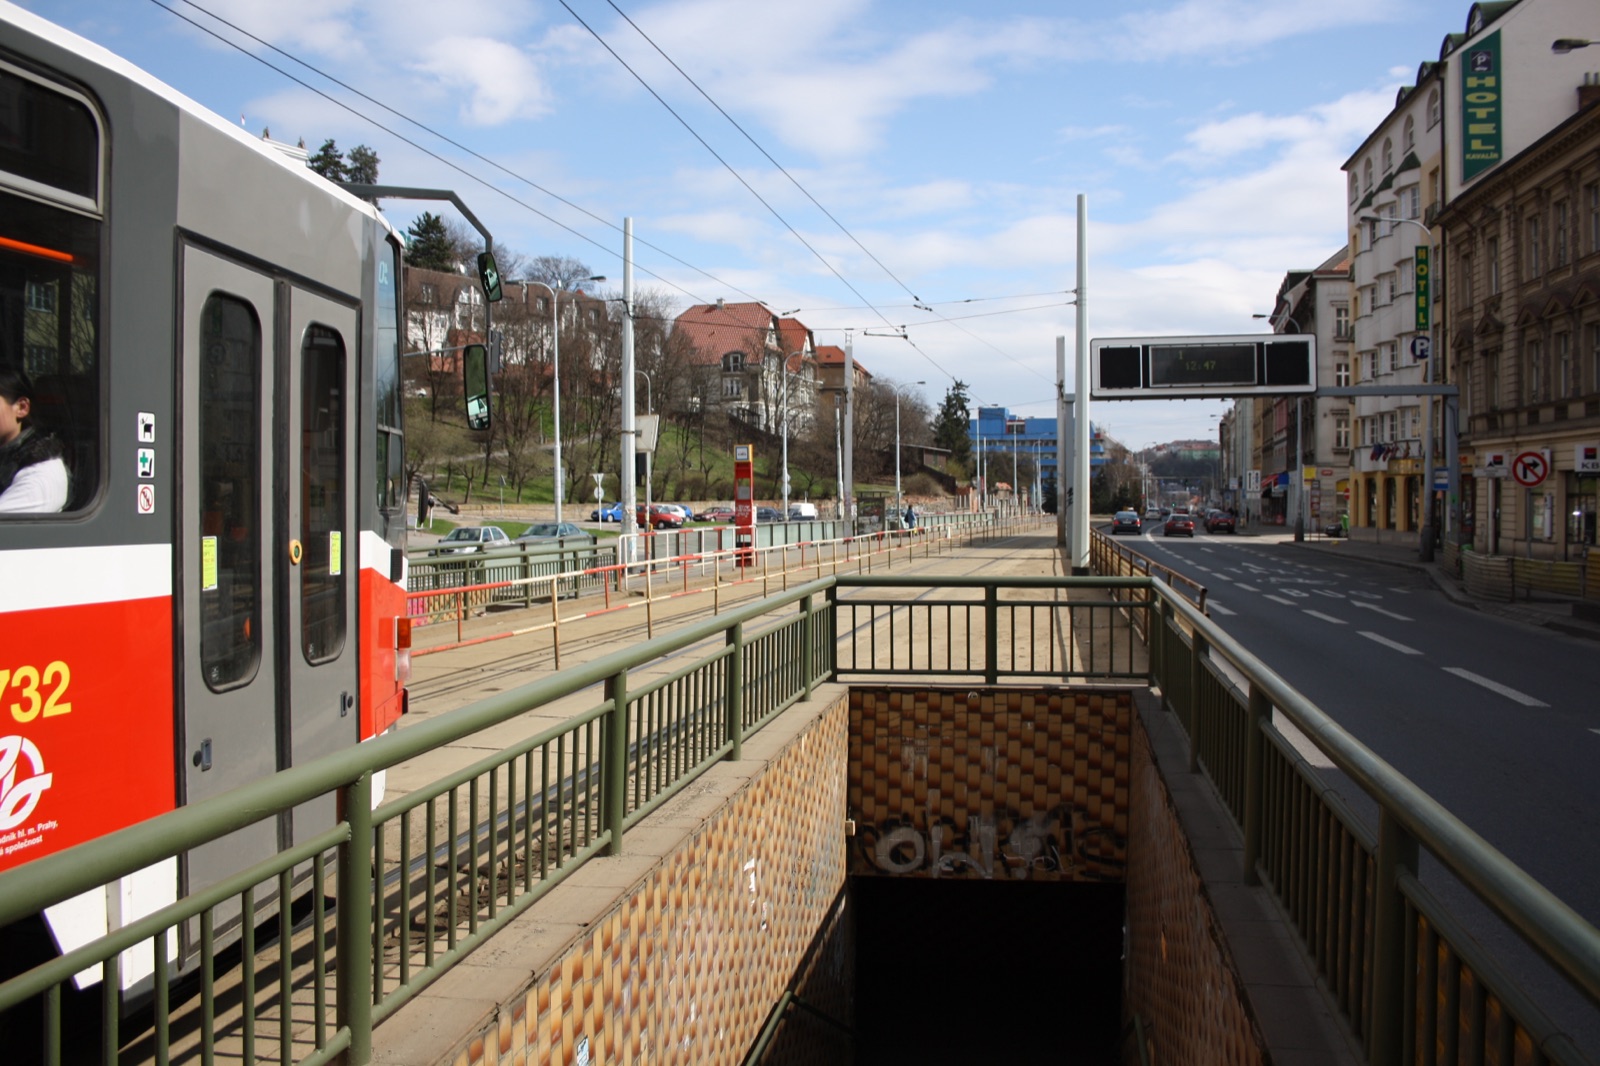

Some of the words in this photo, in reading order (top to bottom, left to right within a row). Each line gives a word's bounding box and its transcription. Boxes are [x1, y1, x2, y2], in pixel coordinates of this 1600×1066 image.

[1466, 76, 1498, 150] HOTEL
[1416, 248, 1428, 323] HOTEL
[1581, 461, 1600, 470] KB
